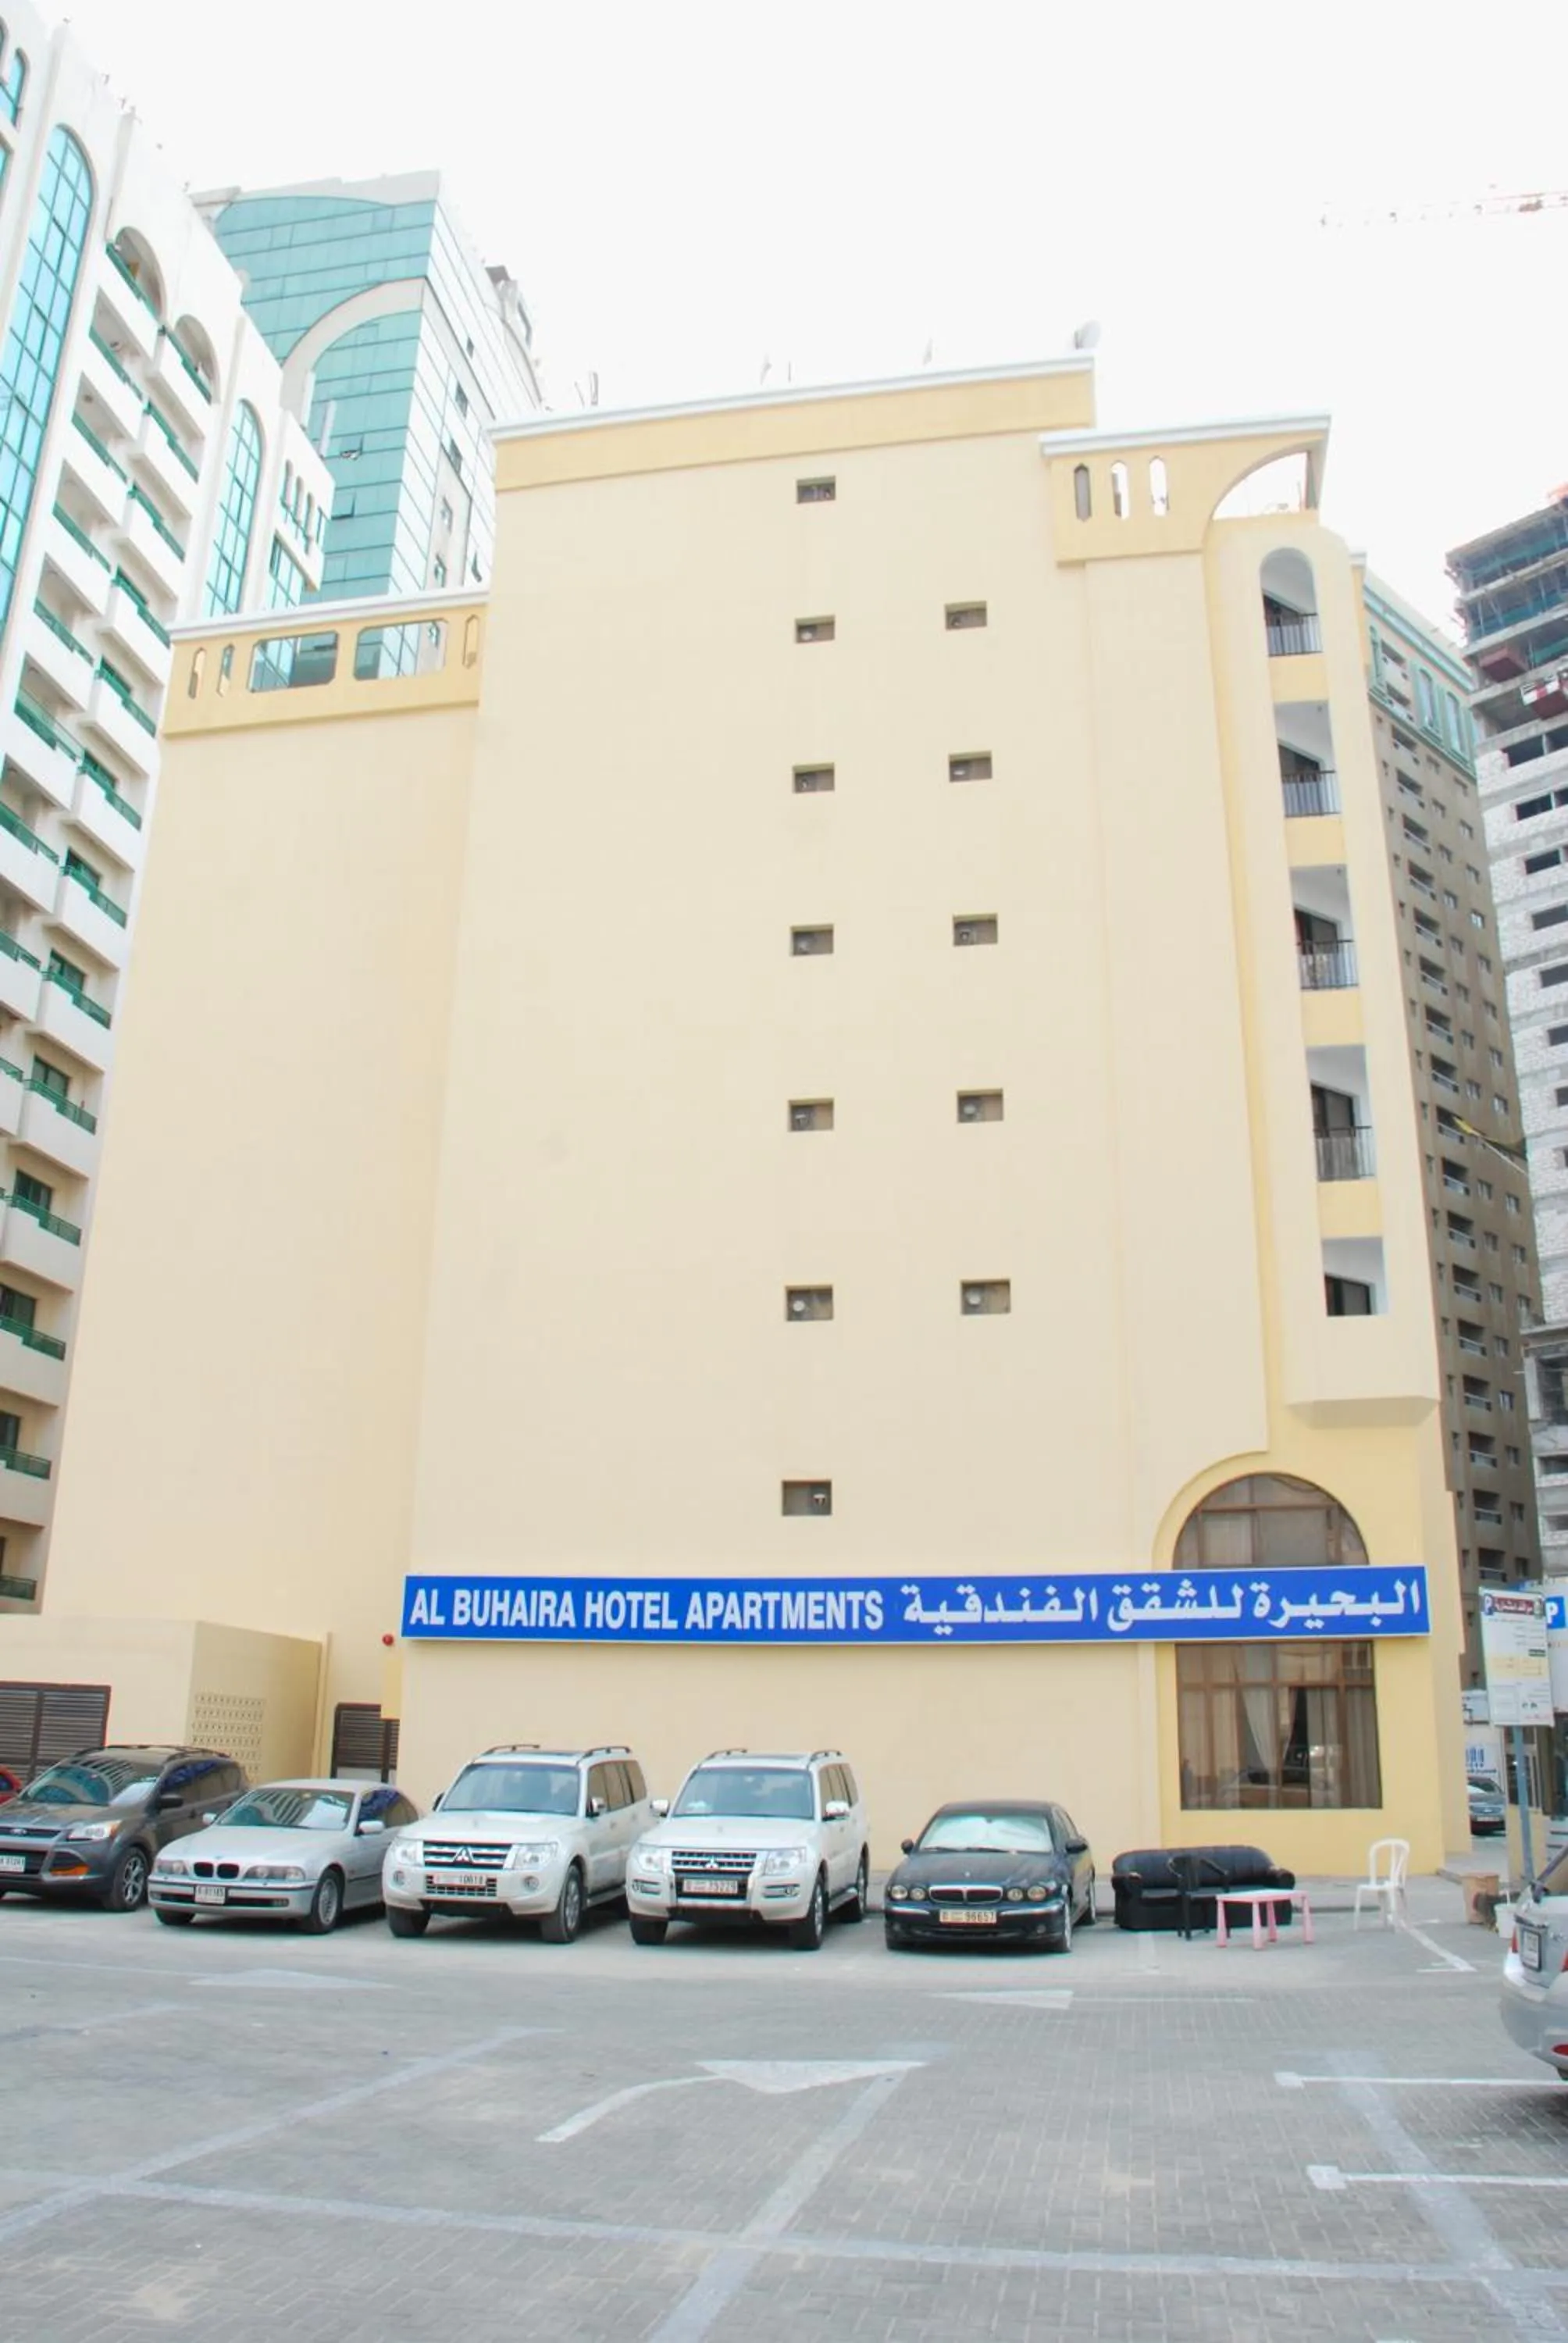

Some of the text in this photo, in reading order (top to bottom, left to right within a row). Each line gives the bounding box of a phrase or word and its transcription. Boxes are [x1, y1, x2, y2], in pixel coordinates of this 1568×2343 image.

[410, 1589, 883, 1630] AL BUHAIRA HOTEL APARTMENTS
[900, 1579, 1420, 1635] البحيرة للشقق الفندقية
[1546, 1601, 1559, 1624] P
